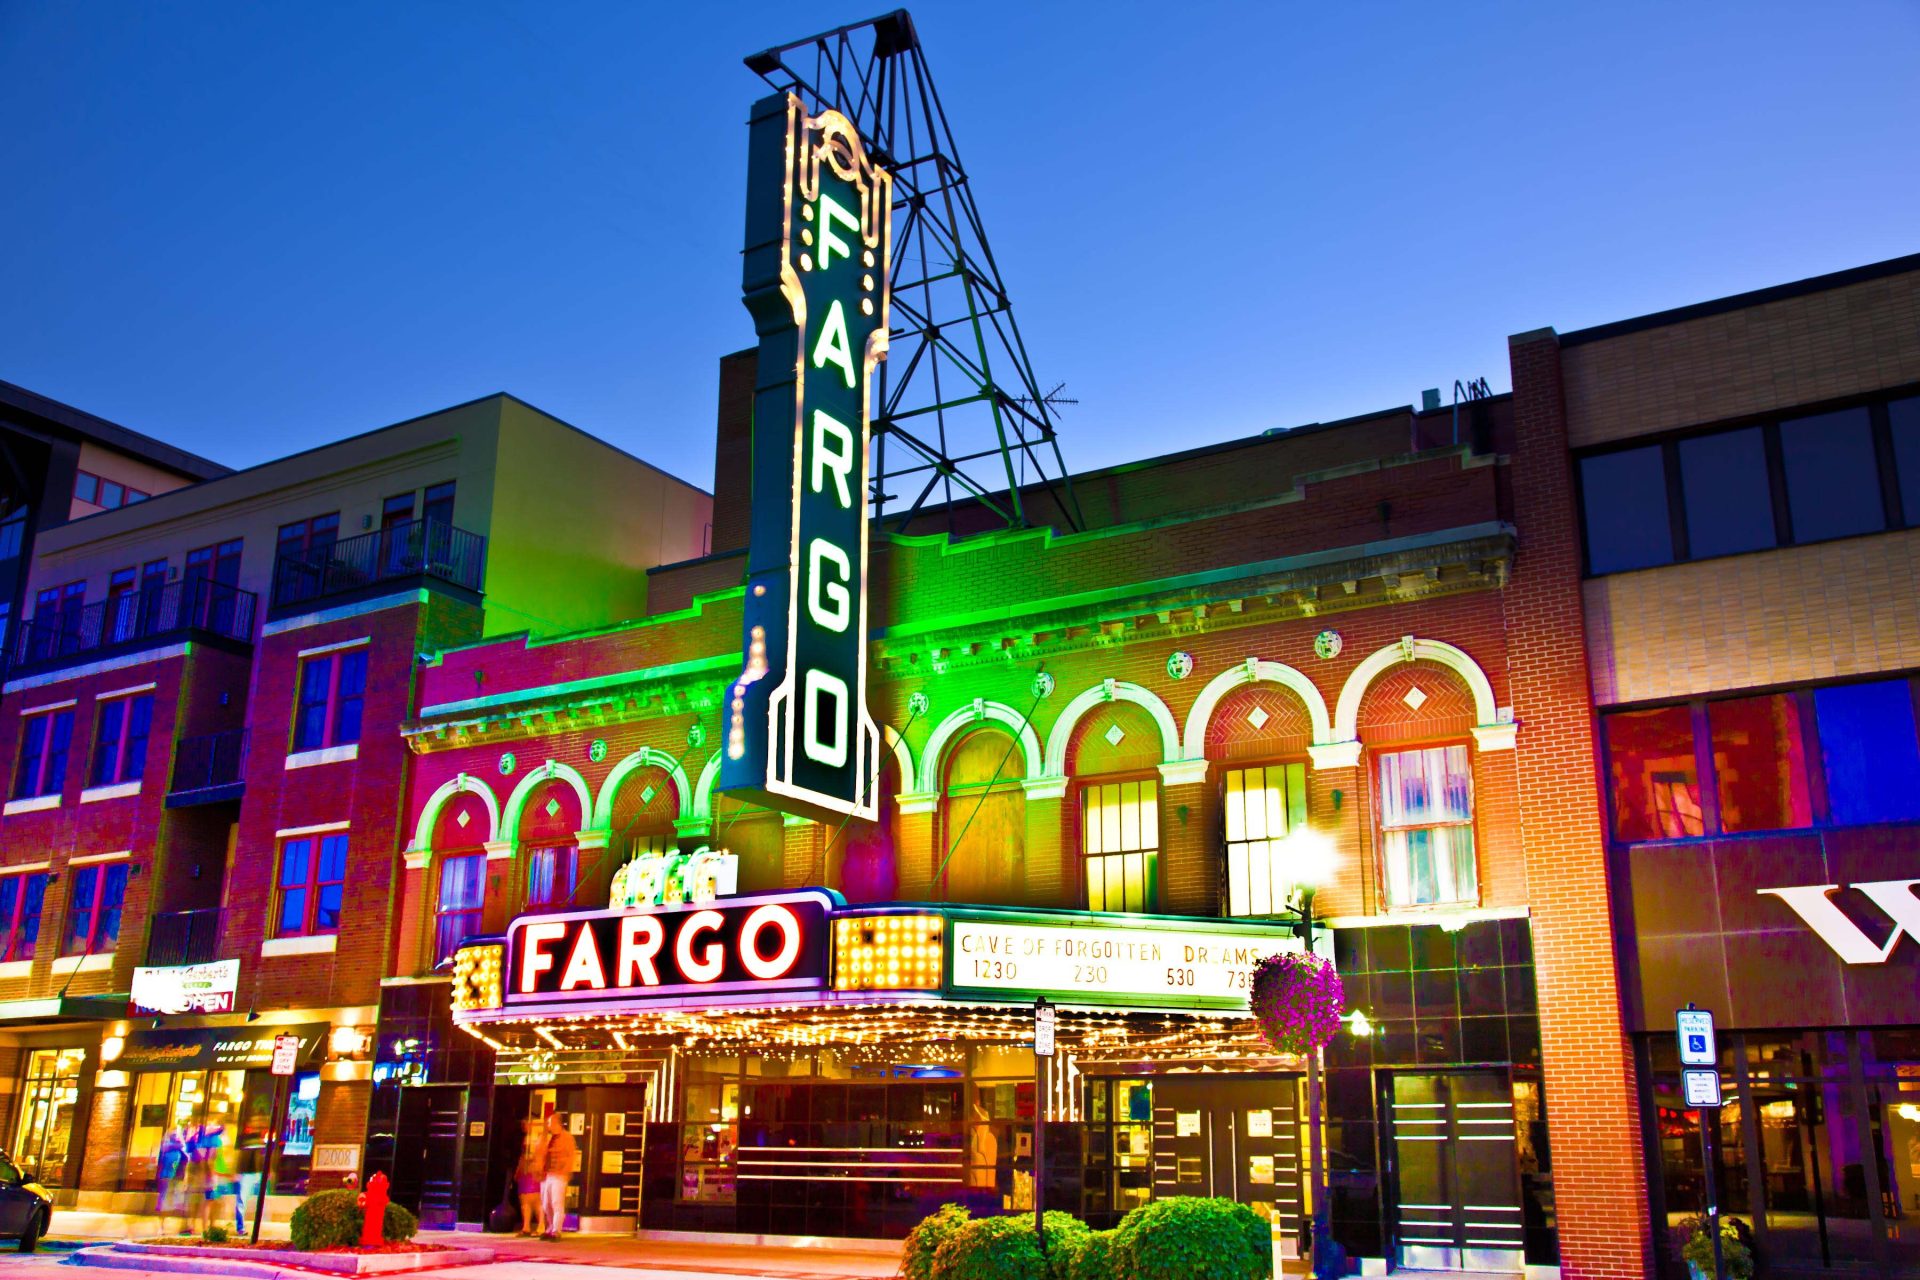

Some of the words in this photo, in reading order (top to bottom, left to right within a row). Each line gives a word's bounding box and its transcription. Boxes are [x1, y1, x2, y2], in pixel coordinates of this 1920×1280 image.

[803, 193, 861, 769] FARGO
[520, 903, 802, 993] FARGO
[961, 934, 1014, 955] CAVE
[1023, 937, 1046, 957] OF
[1055, 938, 1161, 961] FORGOTTEN
[974, 959, 1017, 980] 1230
[1074, 964, 1107, 984] 230
[1167, 967, 1195, 987] 530
[179, 992, 229, 1012] OPEN
[213, 1040, 252, 1051] FARGO
[323, 1149, 352, 1167] 2008
